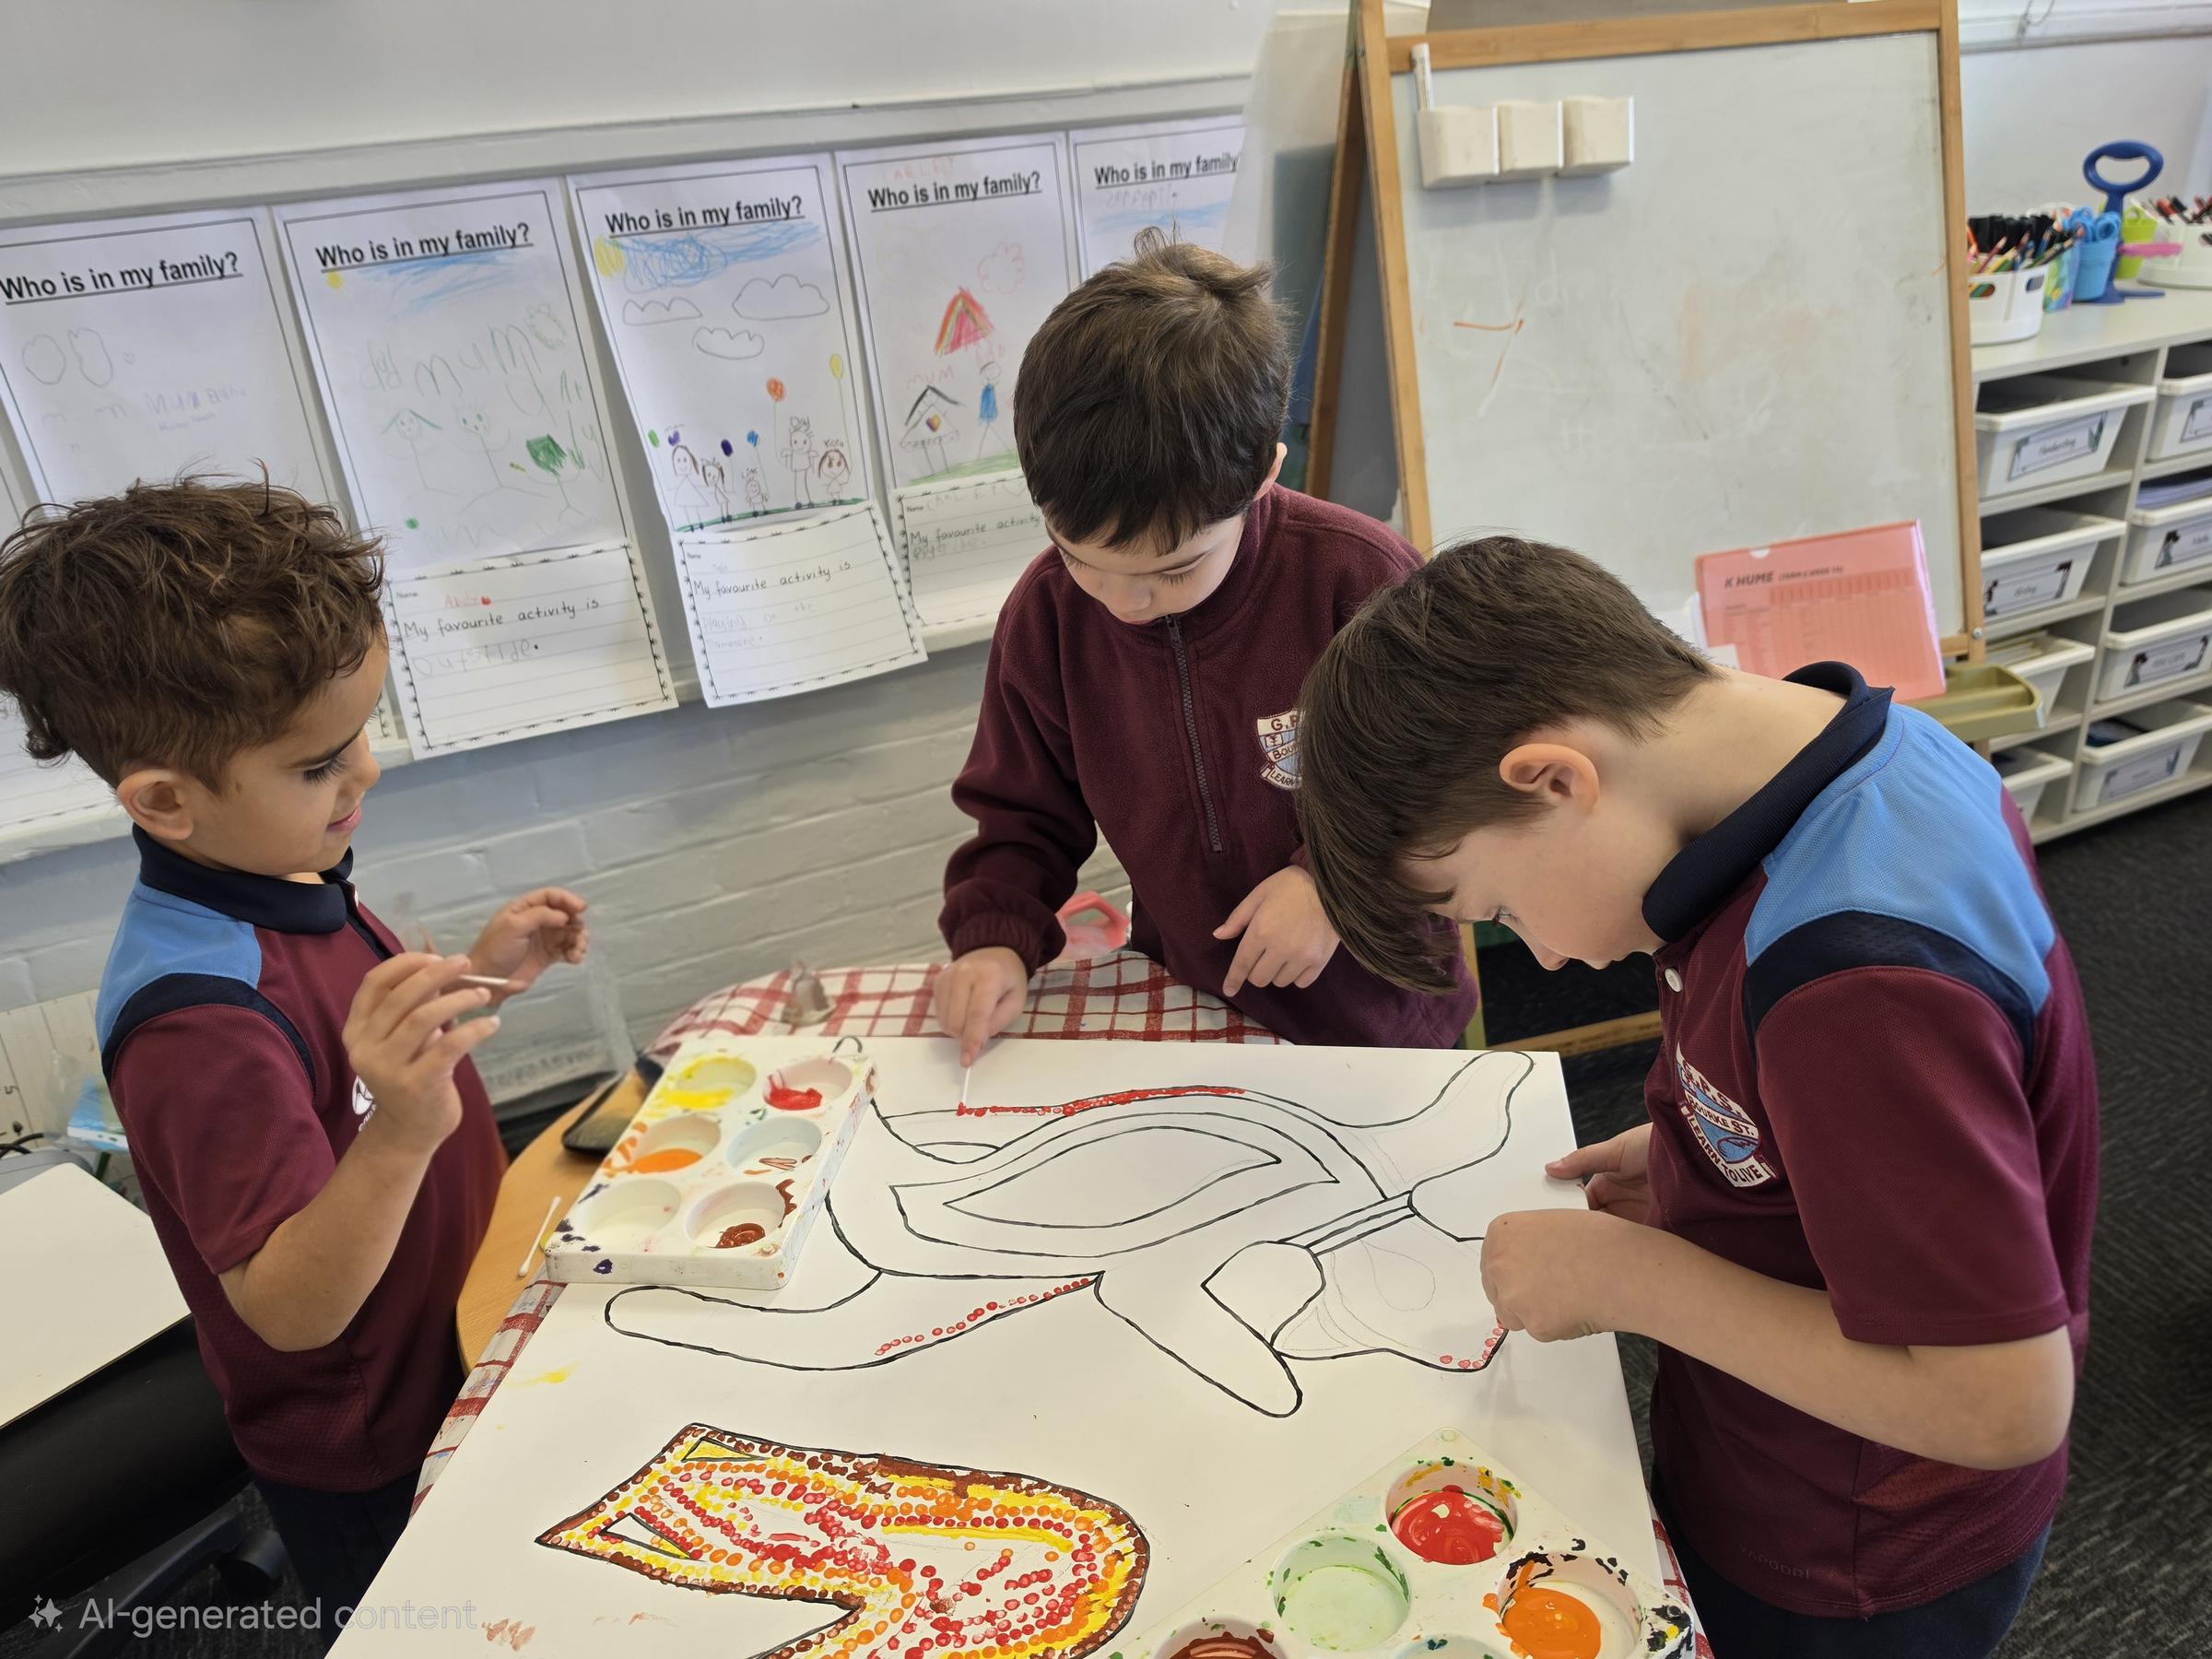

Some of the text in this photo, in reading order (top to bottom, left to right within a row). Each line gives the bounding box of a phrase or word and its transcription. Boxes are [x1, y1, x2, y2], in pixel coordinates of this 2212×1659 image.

[1094, 152, 1240, 184] Who is in my family
[867, 171, 1041, 208] Who is in my family?
[605, 194, 802, 233] Who is in my family?
[315, 222, 530, 268] Who is in my family?
[0, 251, 240, 301] Who is in my family?
[910, 512, 1041, 548] My favourite activity
[693, 560, 852, 600] My favourite activity is
[1724, 576, 1734, 589] K
[1735, 571, 1775, 588] HUME
[404, 597, 599, 641] My favourite activity is
[1688, 1095, 1754, 1135] BOURKE ST.
[1688, 1115, 1762, 1183] LEARN TO LIVE
